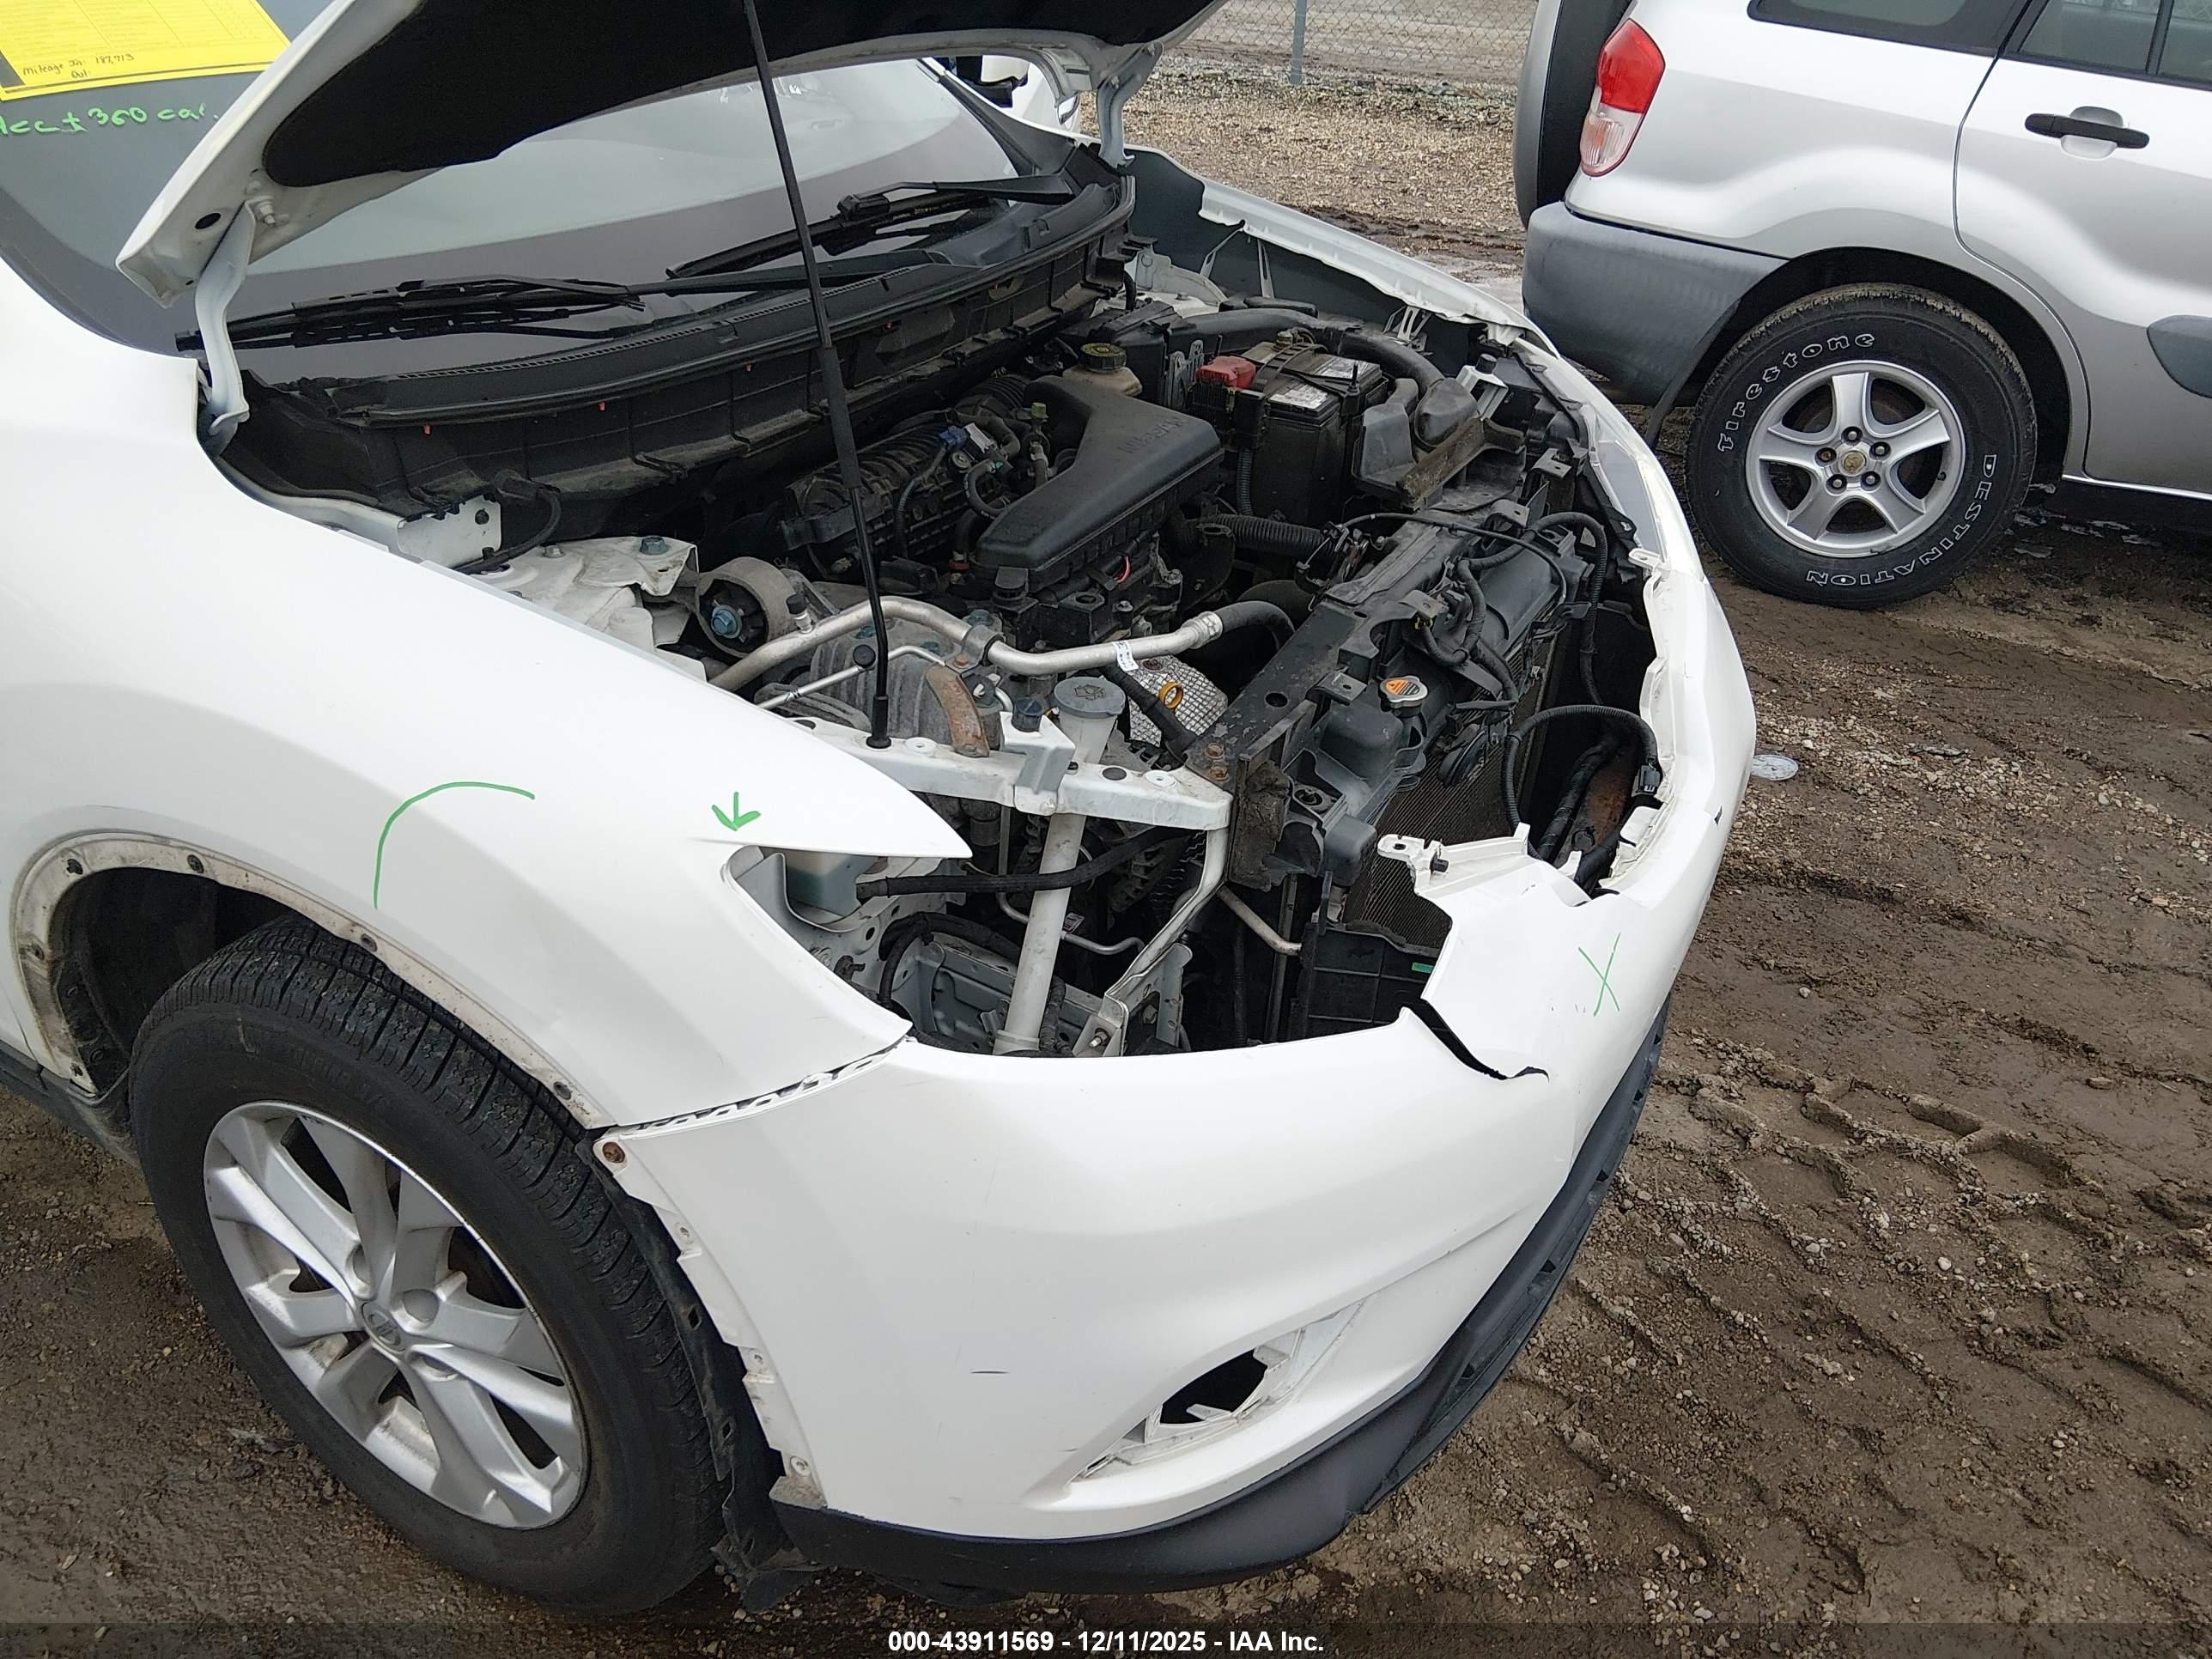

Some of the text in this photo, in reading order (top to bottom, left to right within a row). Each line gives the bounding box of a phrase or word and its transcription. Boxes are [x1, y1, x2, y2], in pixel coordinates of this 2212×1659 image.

[22, 63, 64, 76] Mileage
[87, 106, 148, 125] 360
[1718, 333, 1876, 453] Firestone
[1806, 453, 1998, 587] DESTINATION
